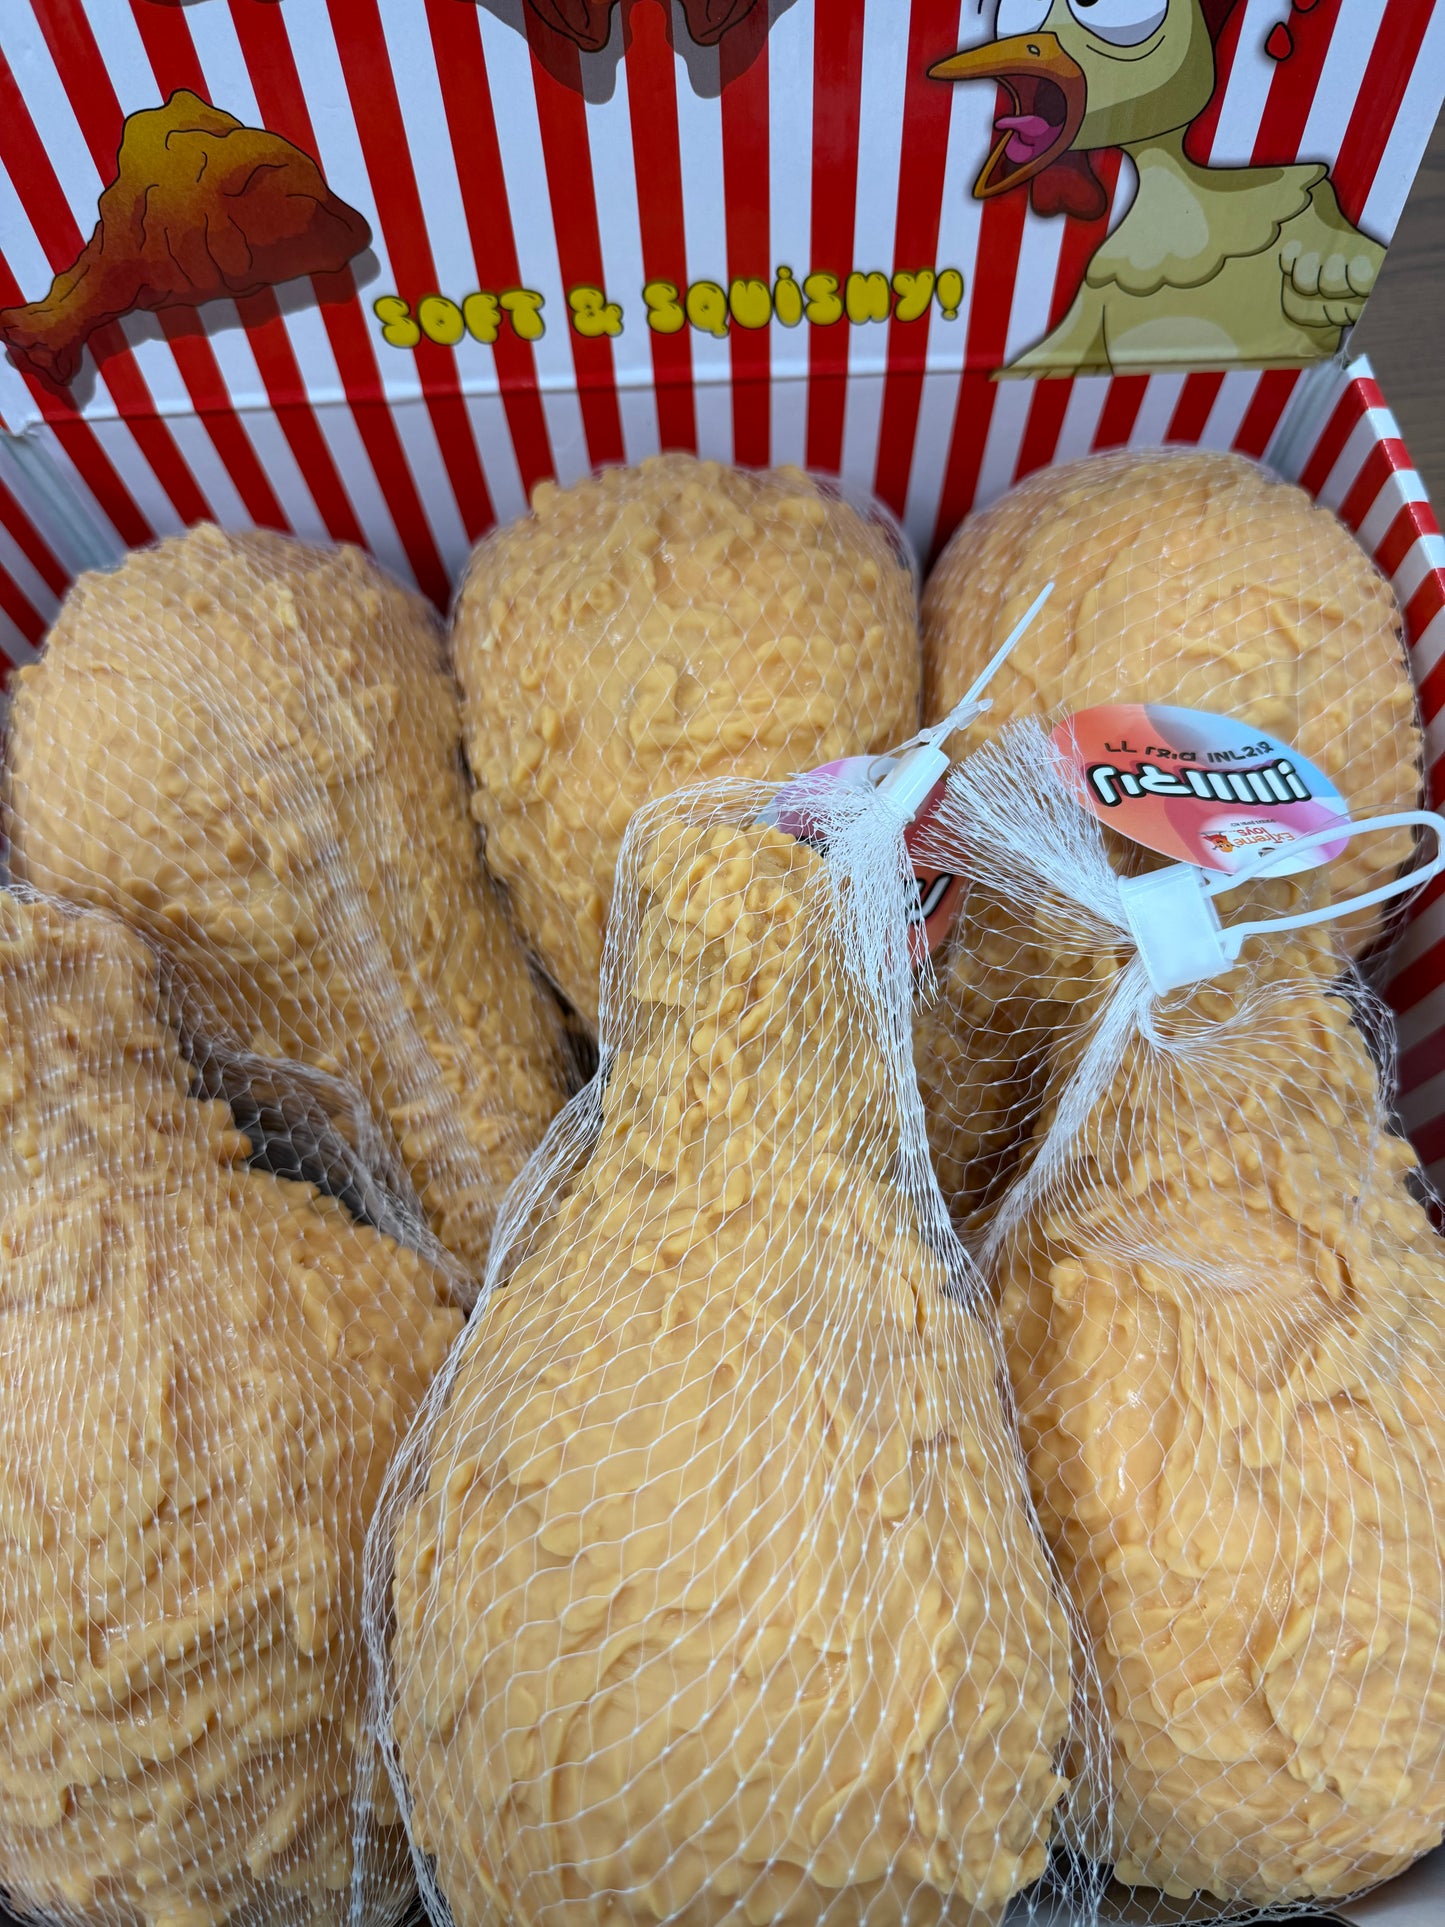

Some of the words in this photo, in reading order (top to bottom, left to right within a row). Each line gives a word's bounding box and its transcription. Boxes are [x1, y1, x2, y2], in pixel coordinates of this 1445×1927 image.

[373, 287, 546, 349] SOFT
[567, 285, 624, 338] &
[1145, 746, 1196, 762] נעים
[1207, 741, 1275, 763] ומרגיע
